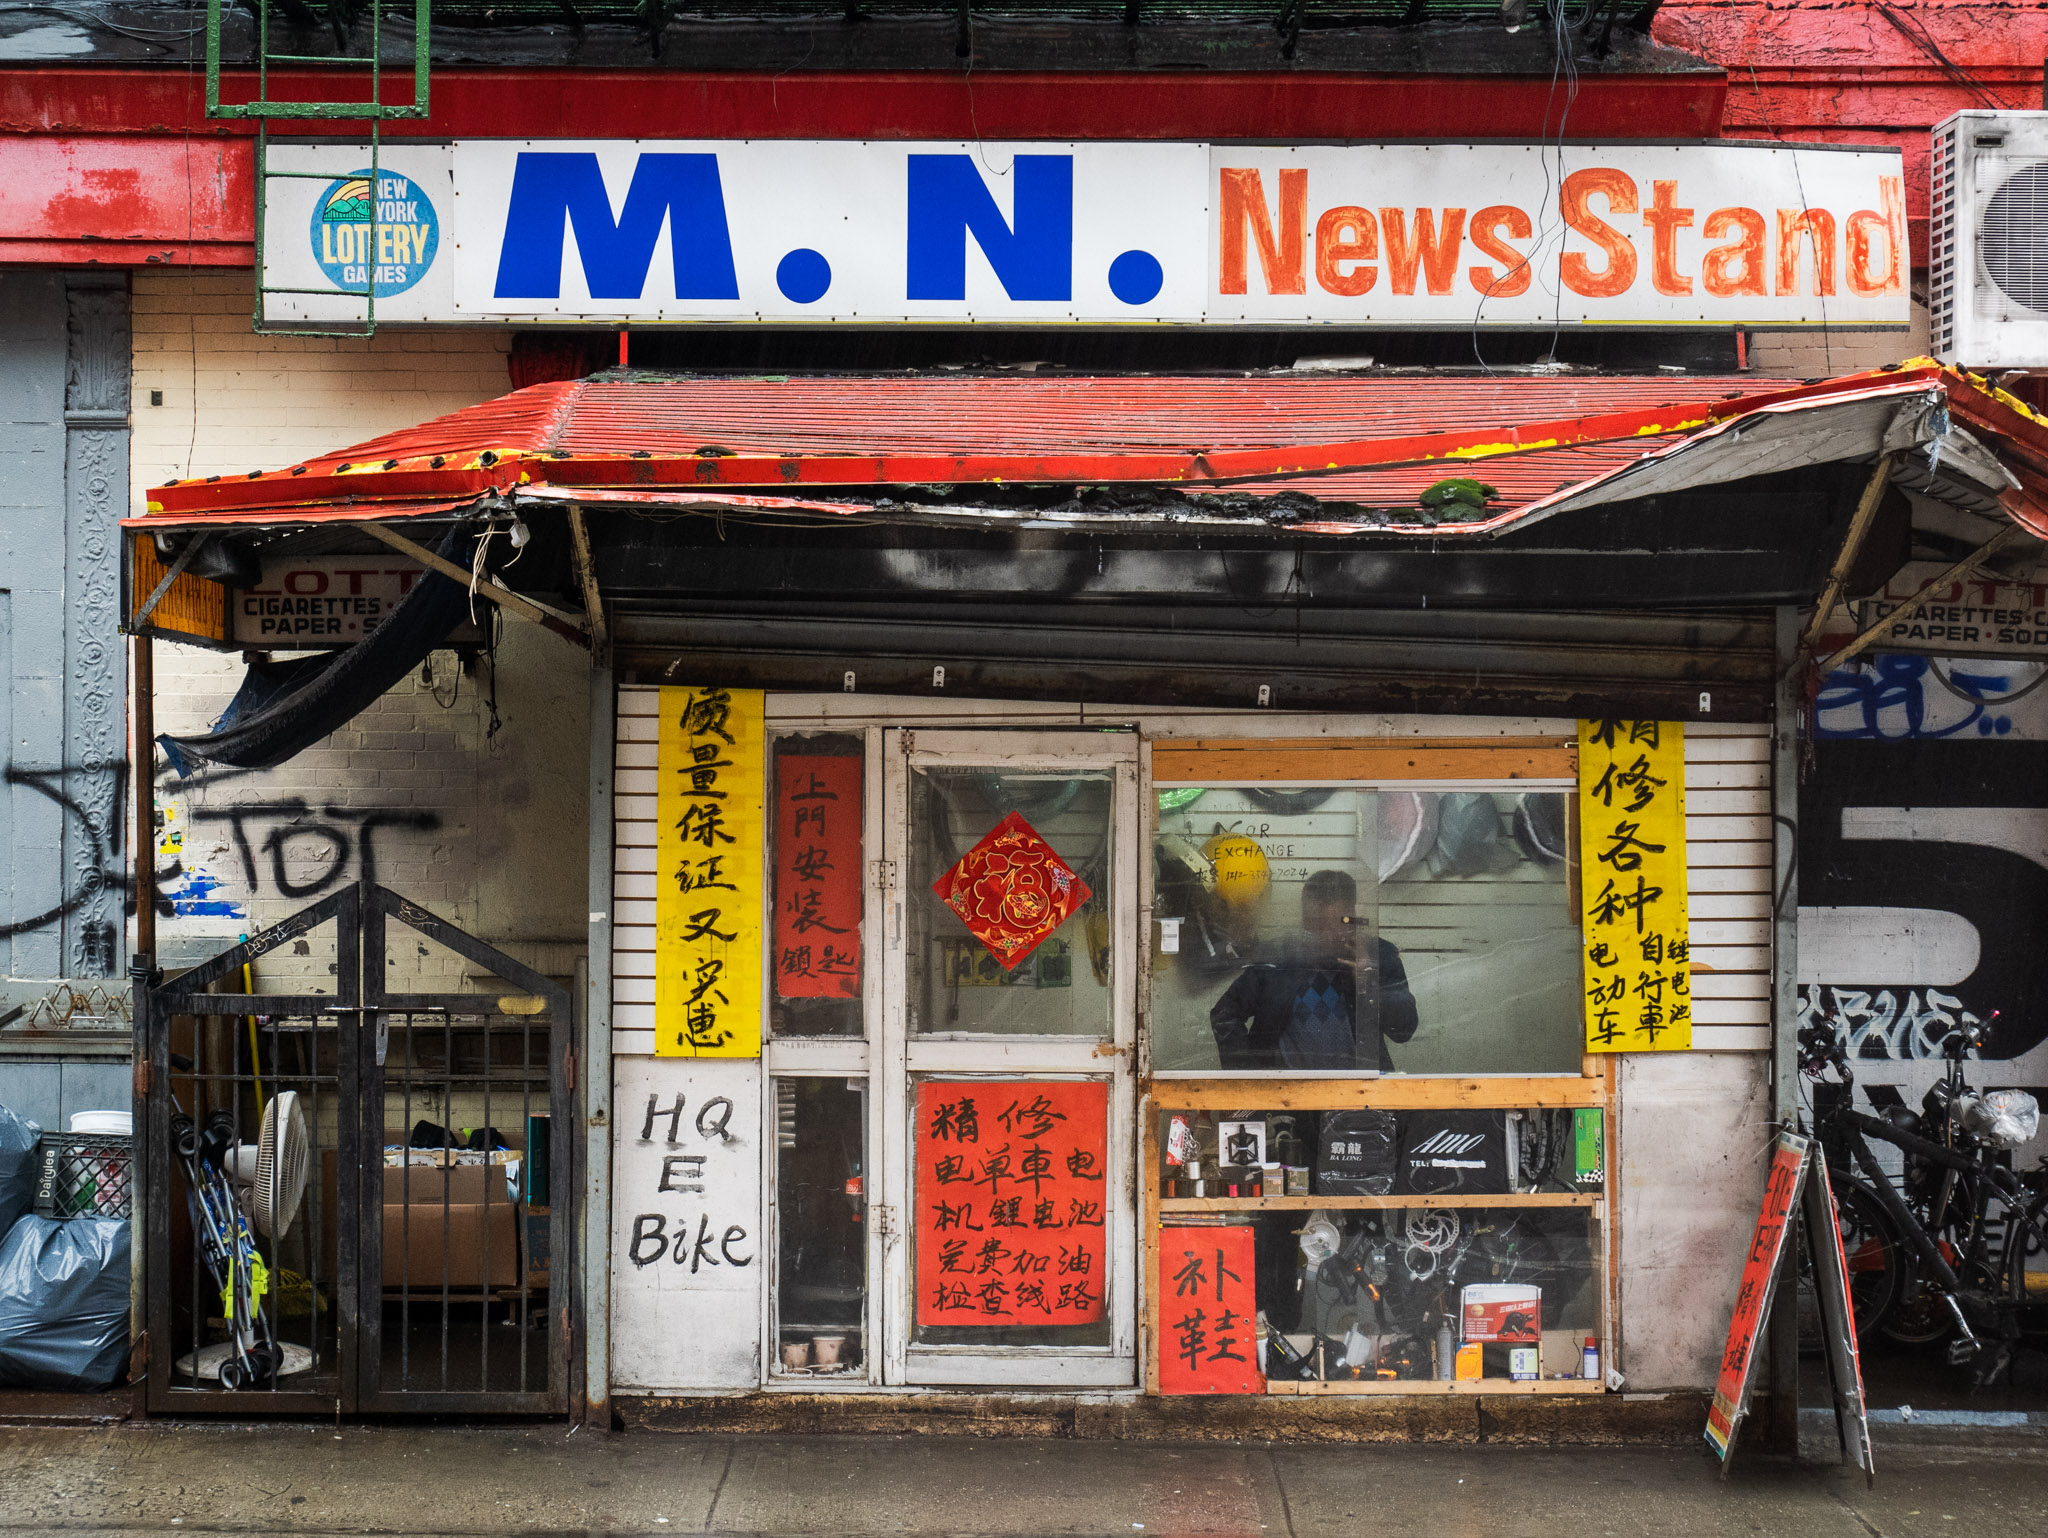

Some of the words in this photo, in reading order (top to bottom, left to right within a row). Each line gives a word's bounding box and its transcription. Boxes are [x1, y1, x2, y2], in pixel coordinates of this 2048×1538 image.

[376, 201, 418, 222] YORK
[494, 152, 832, 304] M.
[906, 153, 1164, 306] N.
[343, 265, 407, 283] GAMES
[243, 598, 381, 616] CIGARETTES
[1875, 604, 2023, 625] CARETTES
[261, 617, 342, 635] PAPER
[1892, 623, 1979, 642] PAPER
[1214, 844, 1295, 860] EXCHANGE
[973, 849, 1051, 929] 福
[640, 1090, 734, 1143] HQ
[931, 1095, 1067, 1144] 精修
[39, 1150, 57, 1198] Dairylea
[658, 1155, 708, 1194] E
[628, 1212, 753, 1275] Bike
